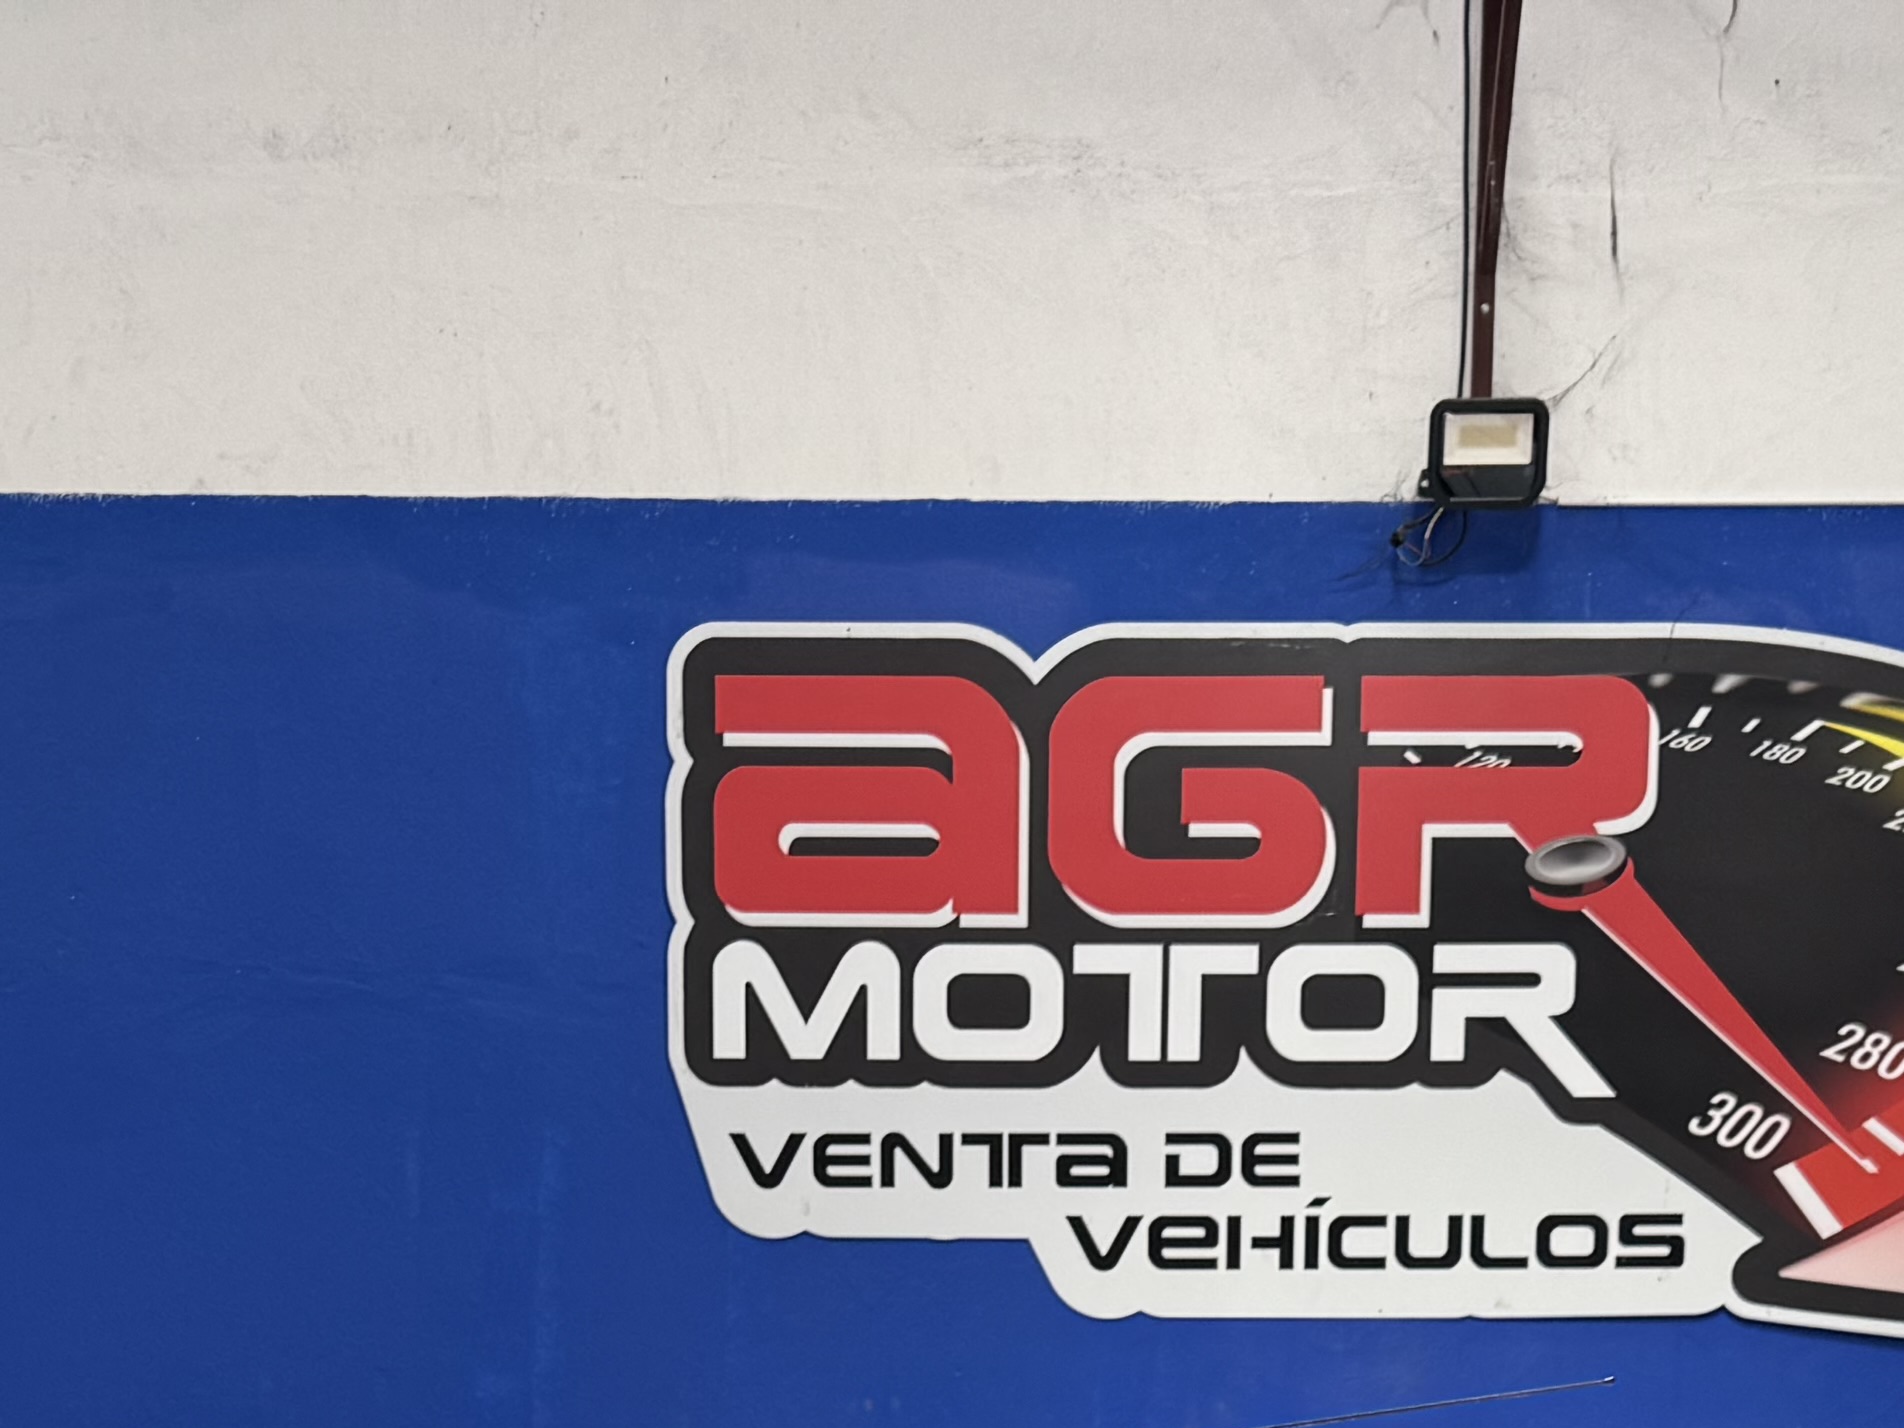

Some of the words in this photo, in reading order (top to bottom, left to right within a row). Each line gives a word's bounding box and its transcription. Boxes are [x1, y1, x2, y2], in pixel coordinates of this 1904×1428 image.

[1658, 728, 1713, 753] 160
[1749, 739, 1807, 764] 180
[1825, 766, 1891, 794] 200
[712, 939, 1617, 1098] MOTOR
[1687, 1091, 1792, 1160] 300
[1164, 1132, 1301, 1188] DE
